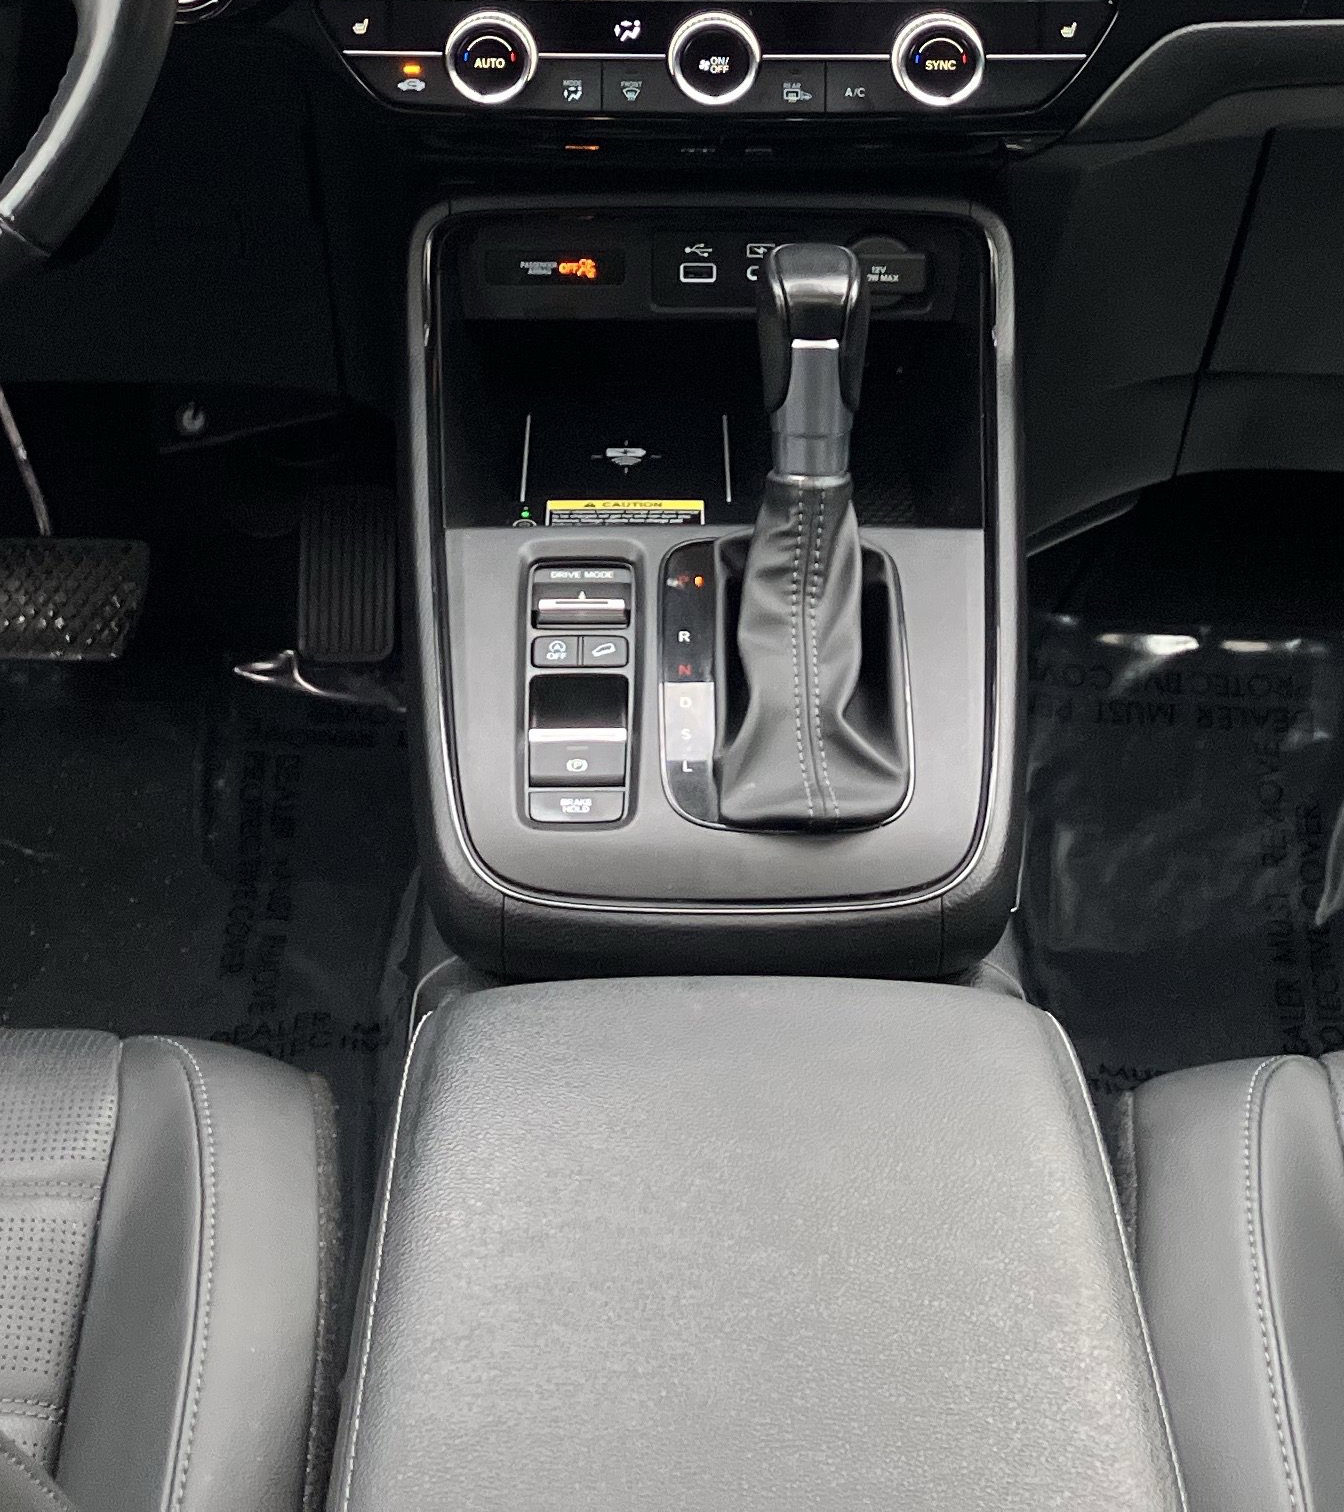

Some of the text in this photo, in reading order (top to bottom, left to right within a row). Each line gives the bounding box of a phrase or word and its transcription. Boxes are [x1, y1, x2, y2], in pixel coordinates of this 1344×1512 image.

[474, 57, 506, 70] AUTO
[925, 60, 957, 72] SYNC
[709, 65, 730, 75] OFF
[844, 87, 866, 98] A/C
[551, 570, 614, 579] DRIVE MODE
[678, 630, 691, 643] R
[678, 664, 691, 676] N
[680, 696, 692, 708] D
[680, 728, 692, 740] S
[682, 761, 693, 773] L
